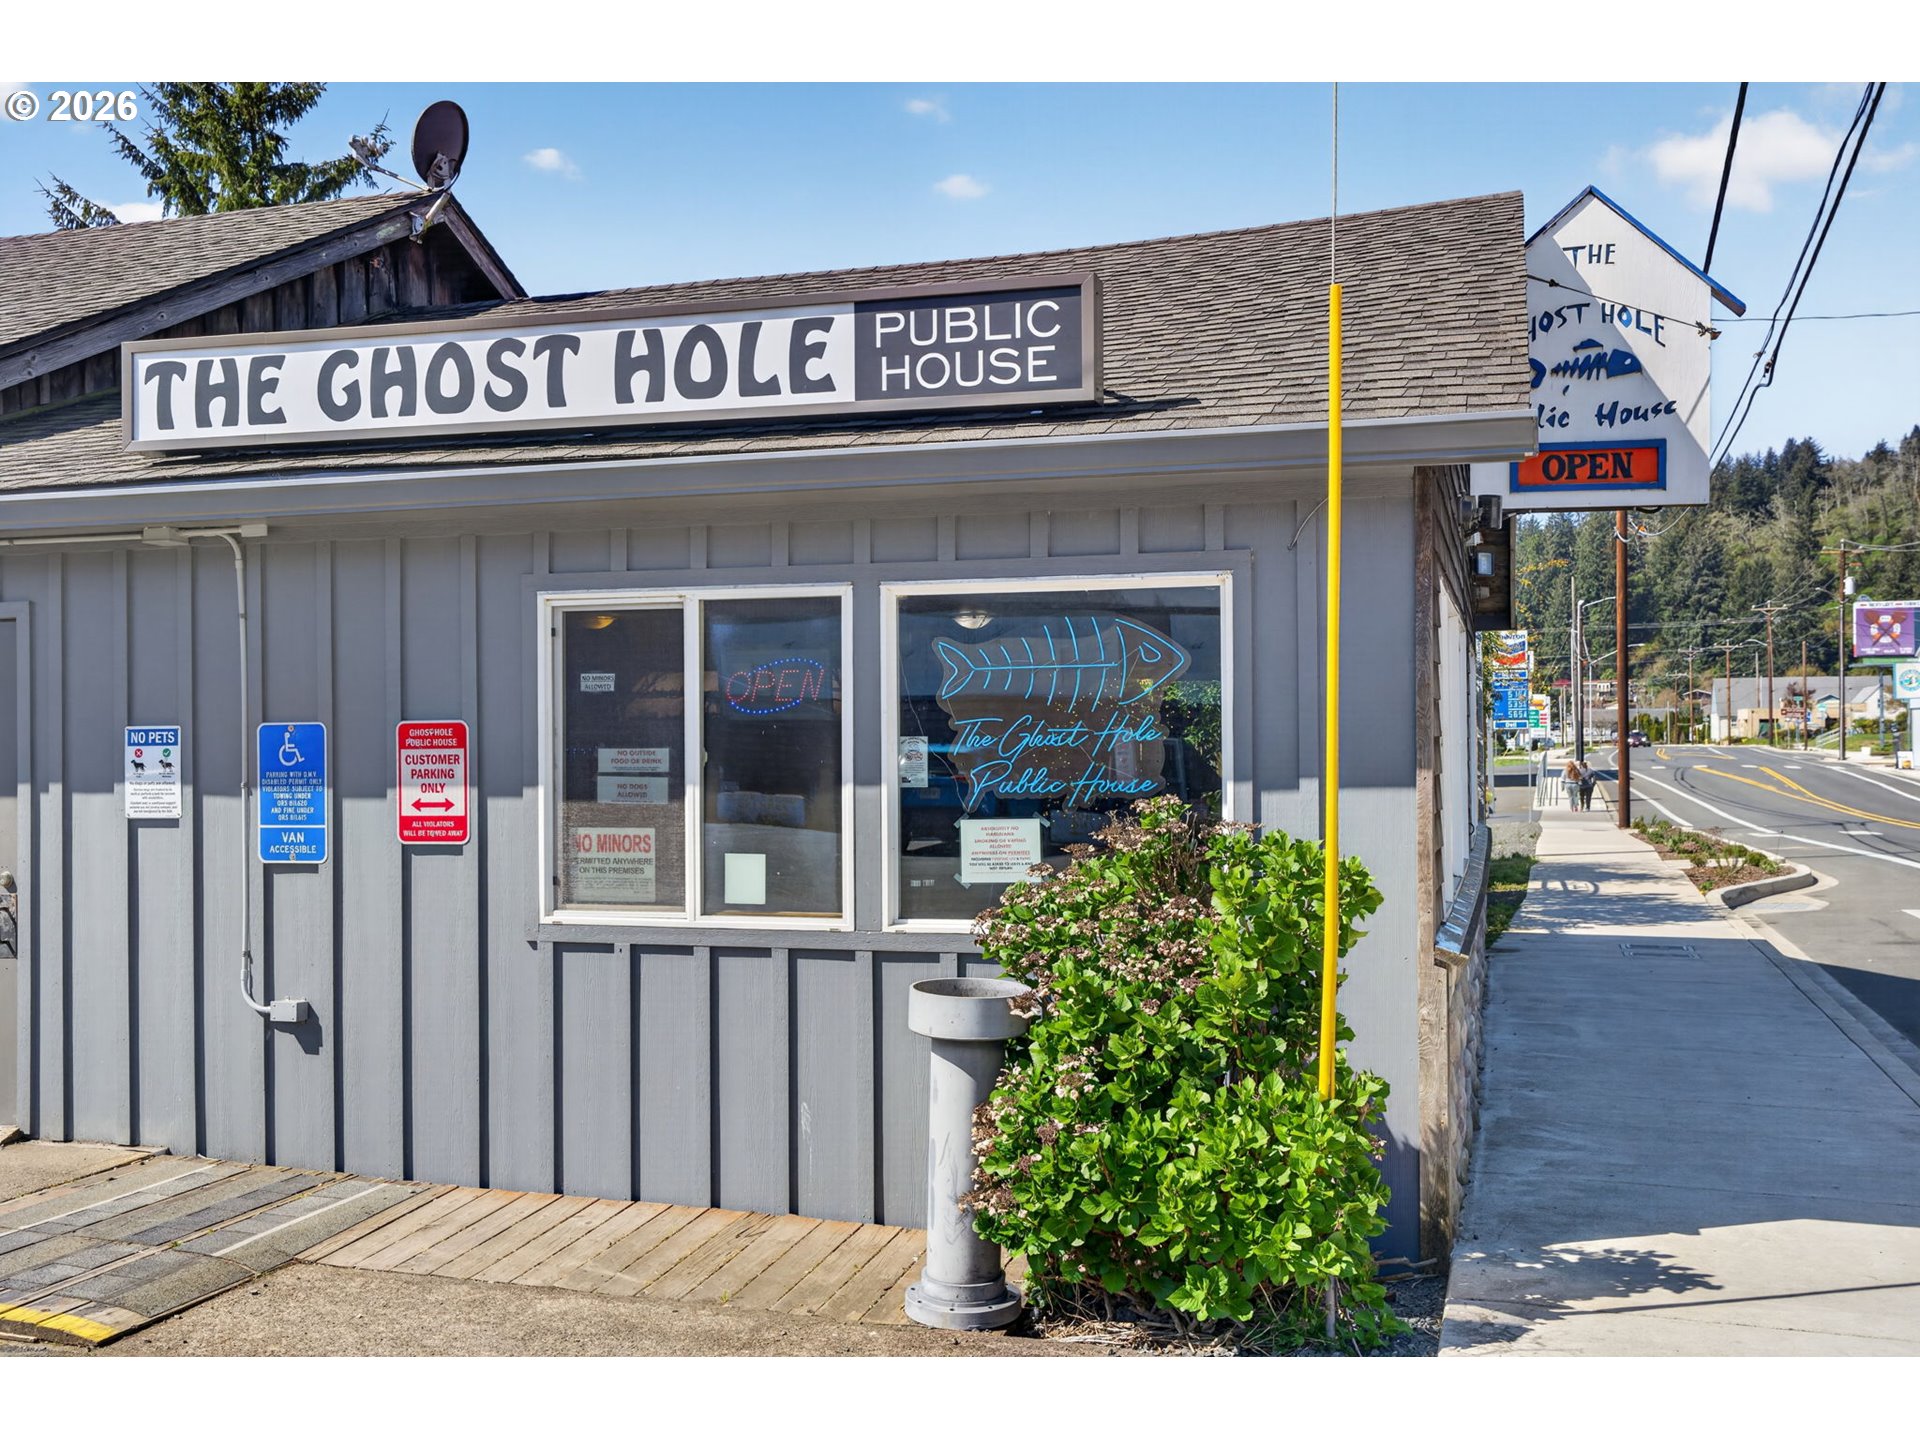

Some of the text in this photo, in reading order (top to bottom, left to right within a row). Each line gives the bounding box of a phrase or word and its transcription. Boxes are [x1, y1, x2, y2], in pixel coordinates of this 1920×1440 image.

[1562, 243, 1616, 272] THE
[875, 301, 1061, 348] PUBLIC
[1601, 303, 1667, 347] HOLE
[144, 317, 837, 430] THE GHOST HOLE
[881, 345, 1057, 392] HOUSE
[1594, 400, 1678, 429] House
[1541, 452, 1634, 482] OPEN
[726, 668, 825, 703] OPEN
[130, 731, 175, 744] NO PETS
[434, 728, 453, 736] HOLE
[954, 711, 1163, 764] The Ghost Hole
[405, 738, 458, 747] PUBLIC HOUSE
[405, 754, 461, 766] CUSTOMER
[411, 768, 455, 780] PARKING
[420, 782, 446, 794] ONLY
[970, 760, 1159, 809] Public House
[281, 831, 305, 843] VAN
[427, 829, 447, 837] TOWED
[269, 845, 317, 854] ACCESSIBLE
[596, 833, 652, 854] MINORS
[612, 857, 654, 866] ANYWHERE
[579, 866, 646, 875] ON THIS PREMISES
